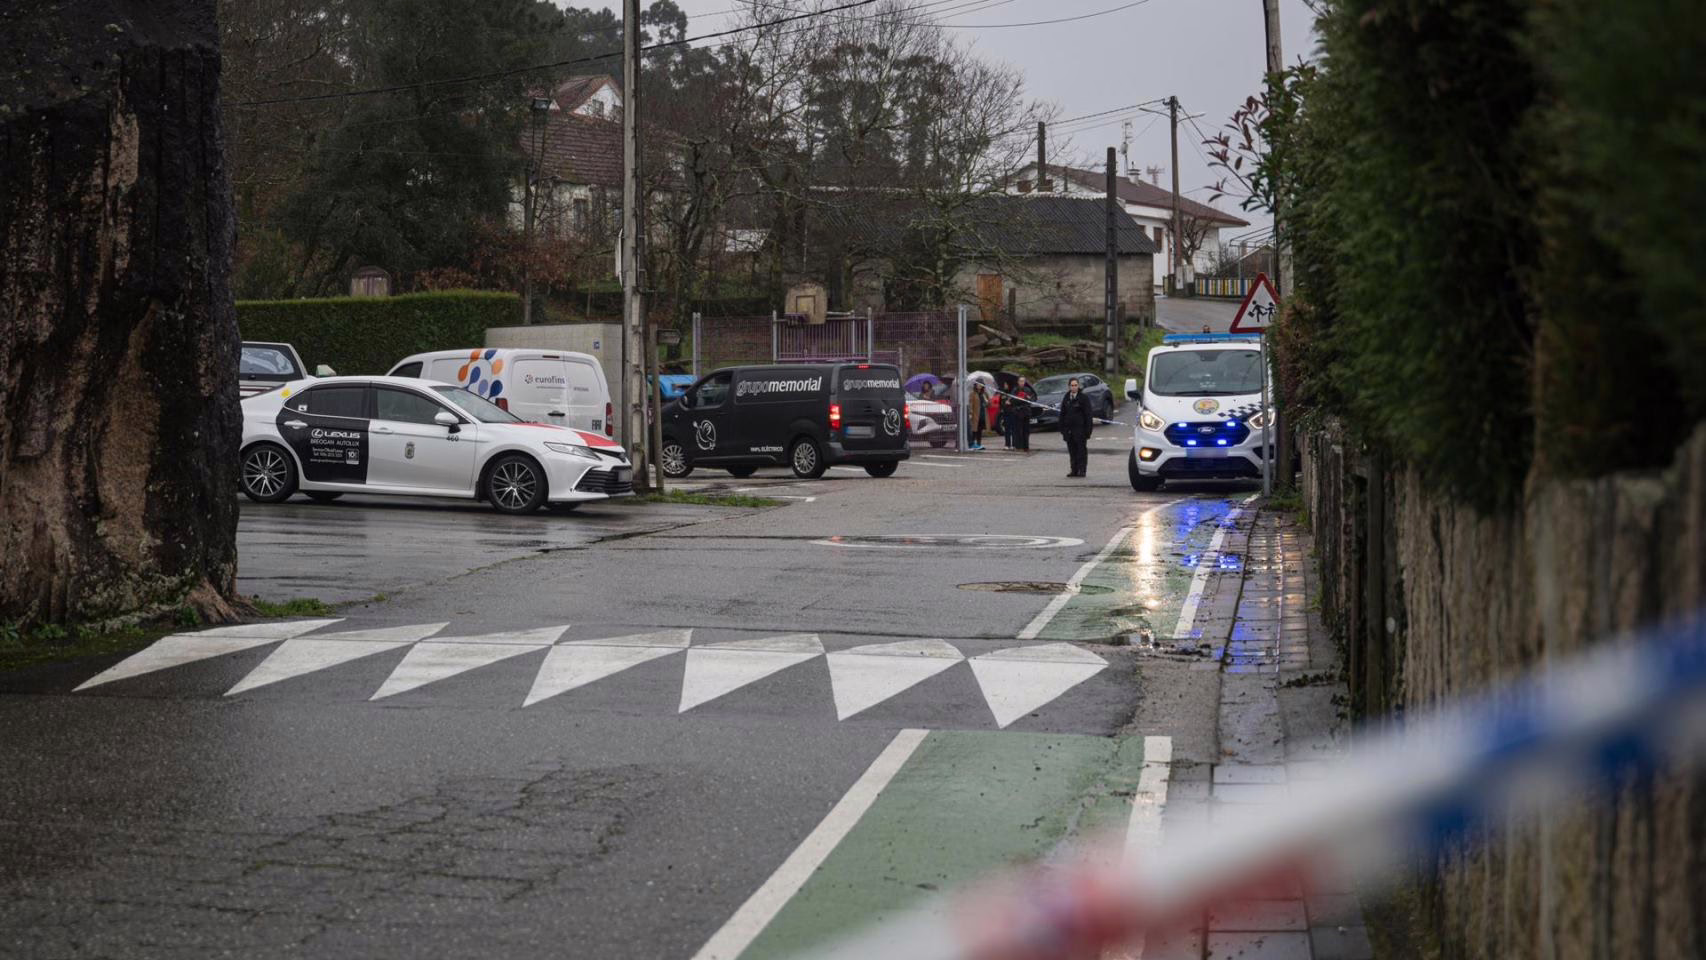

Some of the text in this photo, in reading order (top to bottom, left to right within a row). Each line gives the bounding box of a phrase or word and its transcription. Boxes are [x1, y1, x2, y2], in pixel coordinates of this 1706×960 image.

[535, 375, 565, 384] eurofins
[736, 376, 822, 396] grupomemorial
[843, 378, 900, 391] grupomemorial
[324, 431, 360, 439] LEXUS
[446, 435, 459, 443] 460
